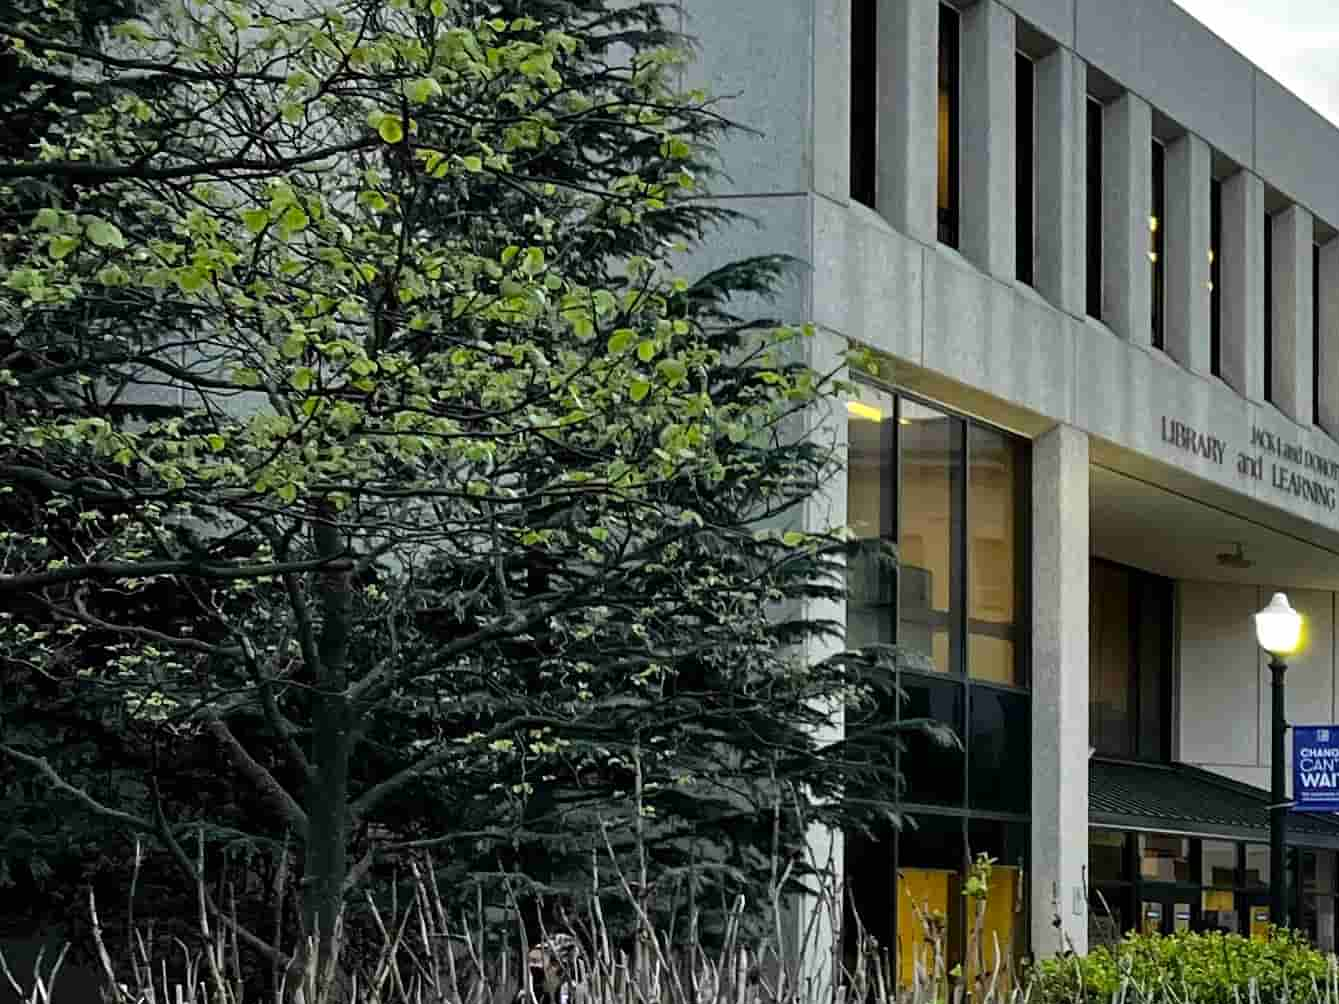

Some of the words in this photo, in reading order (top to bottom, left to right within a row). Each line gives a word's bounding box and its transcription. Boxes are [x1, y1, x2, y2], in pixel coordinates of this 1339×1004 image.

[1162, 416, 1227, 464] LIBRARY
[1237, 452, 1263, 480] and
[1272, 463, 1336, 511] LEARNING
[1250, 424, 1275, 454] JACK
[1284, 442, 1304, 465] and
